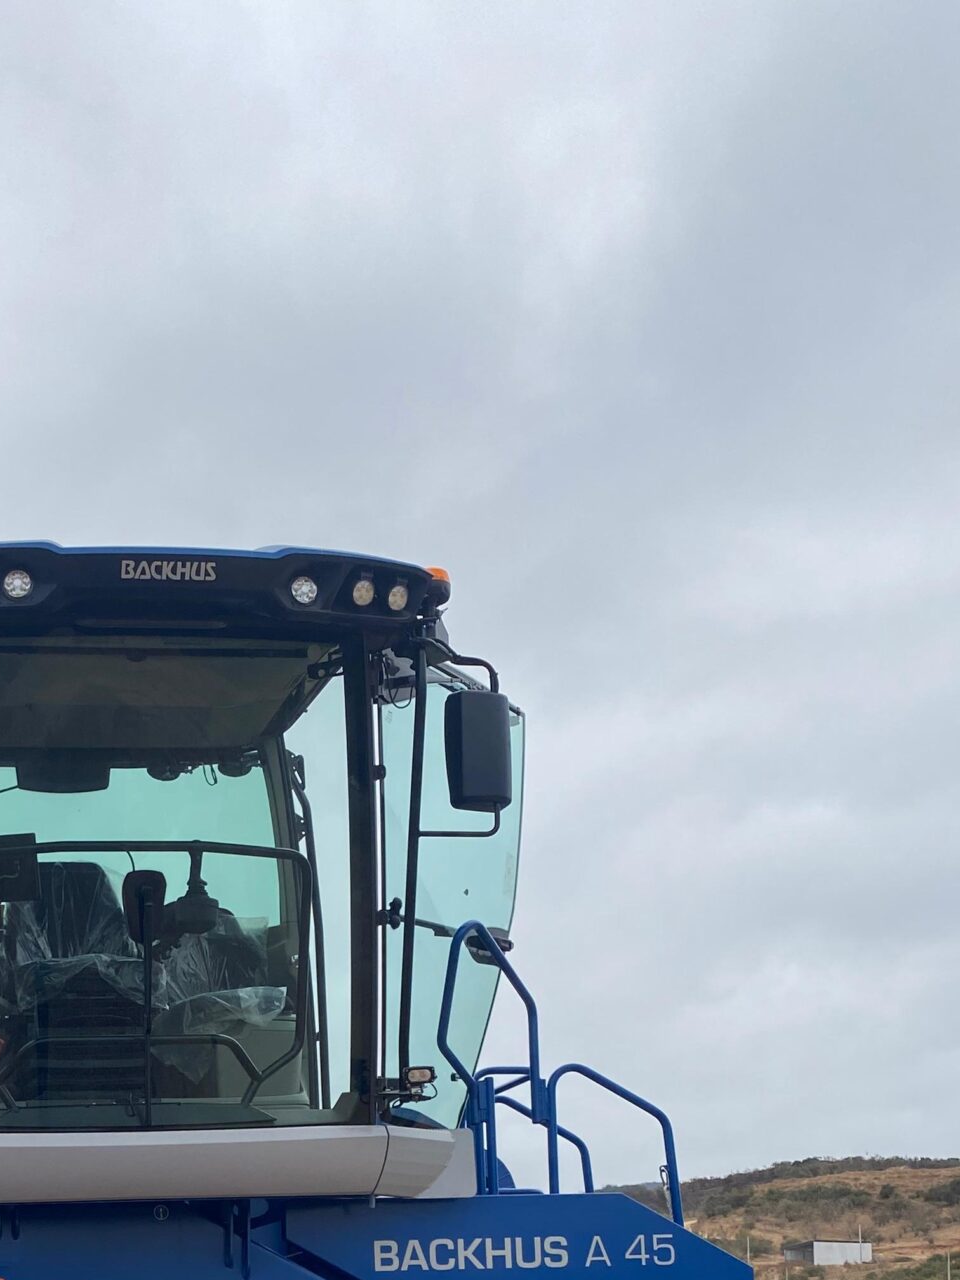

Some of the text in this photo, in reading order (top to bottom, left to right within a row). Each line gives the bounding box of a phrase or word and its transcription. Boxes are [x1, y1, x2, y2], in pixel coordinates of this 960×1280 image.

[121, 560, 216, 581] BACKHUS
[373, 1233, 676, 1272] BACKHUS A 45
